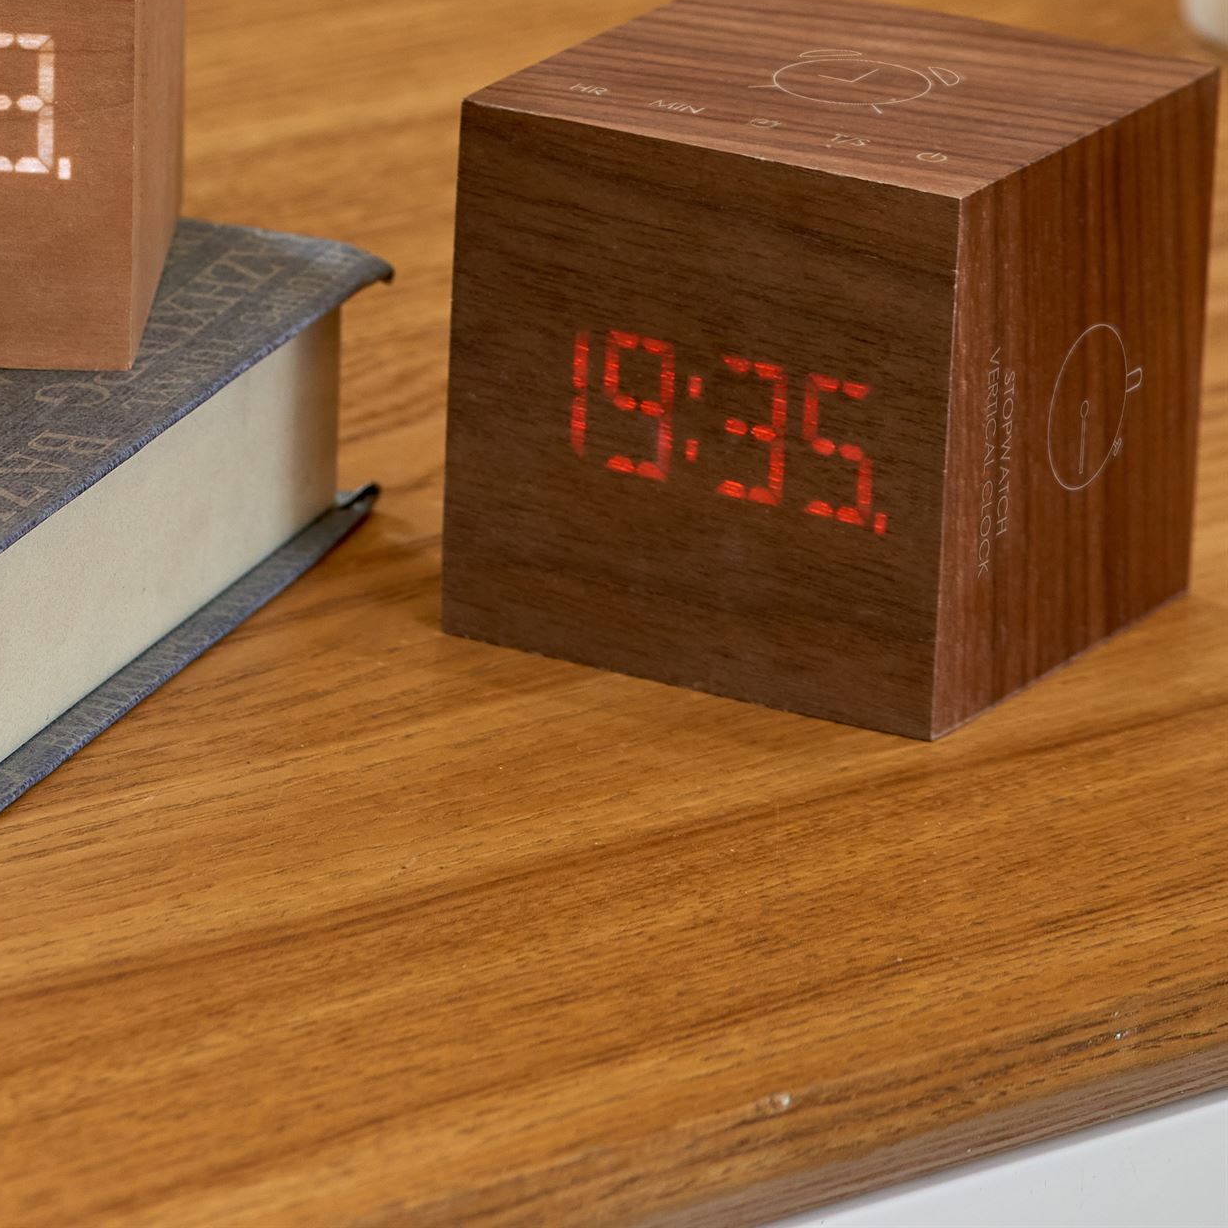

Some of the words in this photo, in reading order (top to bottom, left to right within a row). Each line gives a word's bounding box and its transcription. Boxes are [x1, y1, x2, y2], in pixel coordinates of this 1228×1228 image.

[570, 82, 608, 97] HR
[648, 99, 706, 115] MIN
[983, 347, 1001, 474] VERTICAL
[995, 371, 1016, 536] STOPWATCH
[977, 480, 994, 579] CLOCK
